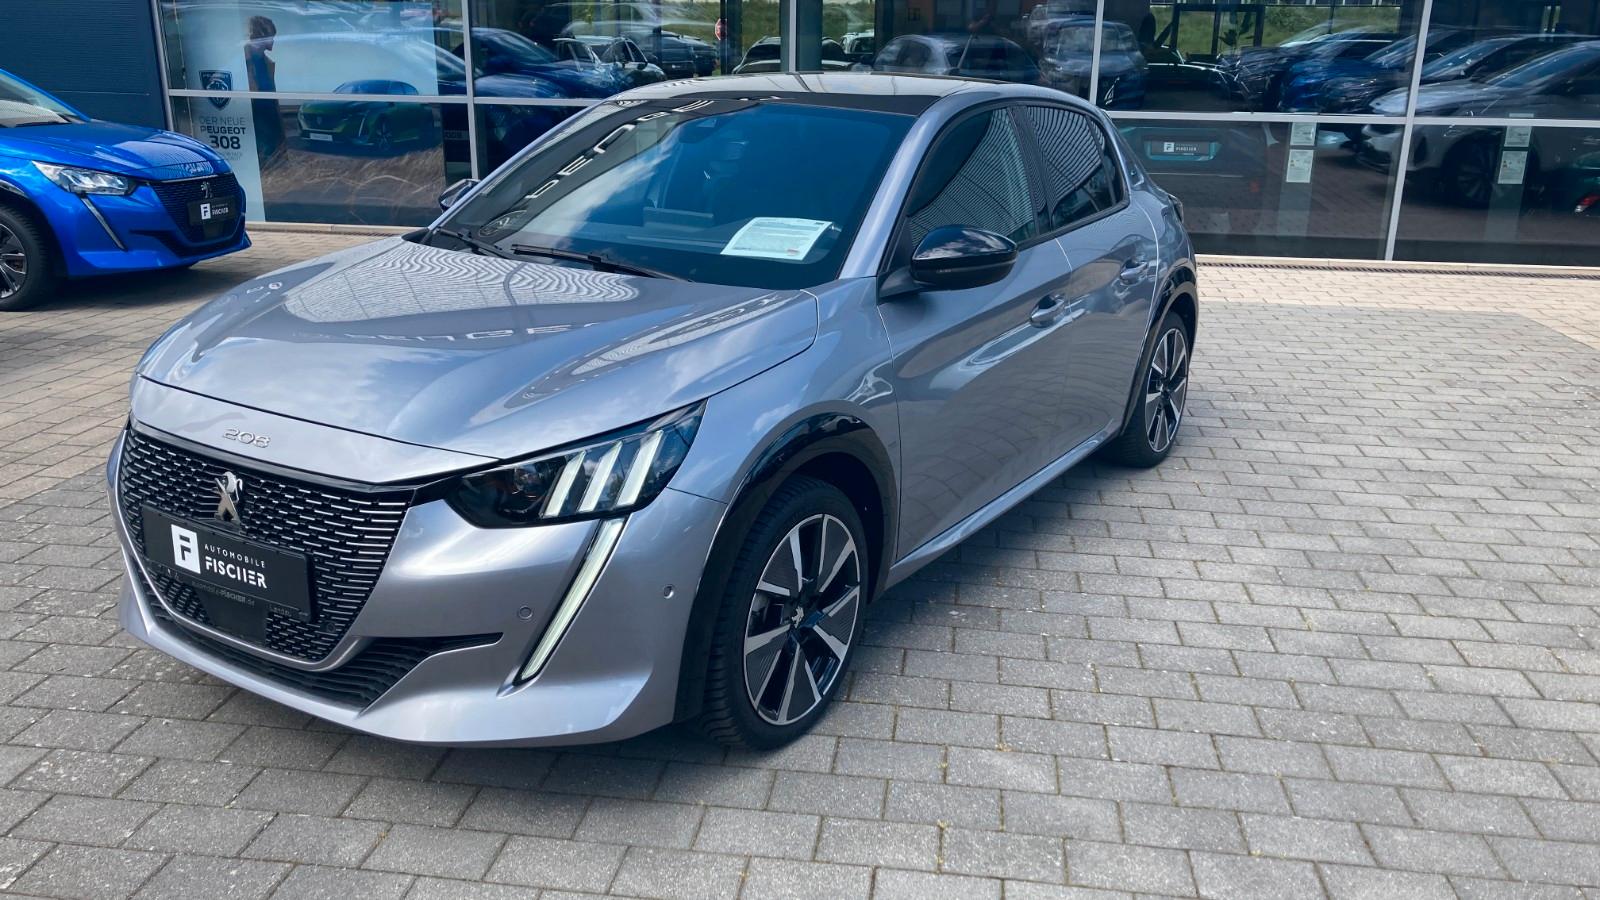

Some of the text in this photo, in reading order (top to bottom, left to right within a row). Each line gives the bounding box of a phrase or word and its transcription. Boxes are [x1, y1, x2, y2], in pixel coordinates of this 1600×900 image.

[200, 116, 246, 126] DER NEUE
[200, 125, 247, 135] PEUGEOT
[208, 136, 241, 149] 308
[204, 543, 265, 569] AUTOMOBILE
[205, 556, 268, 589] FISCHER
